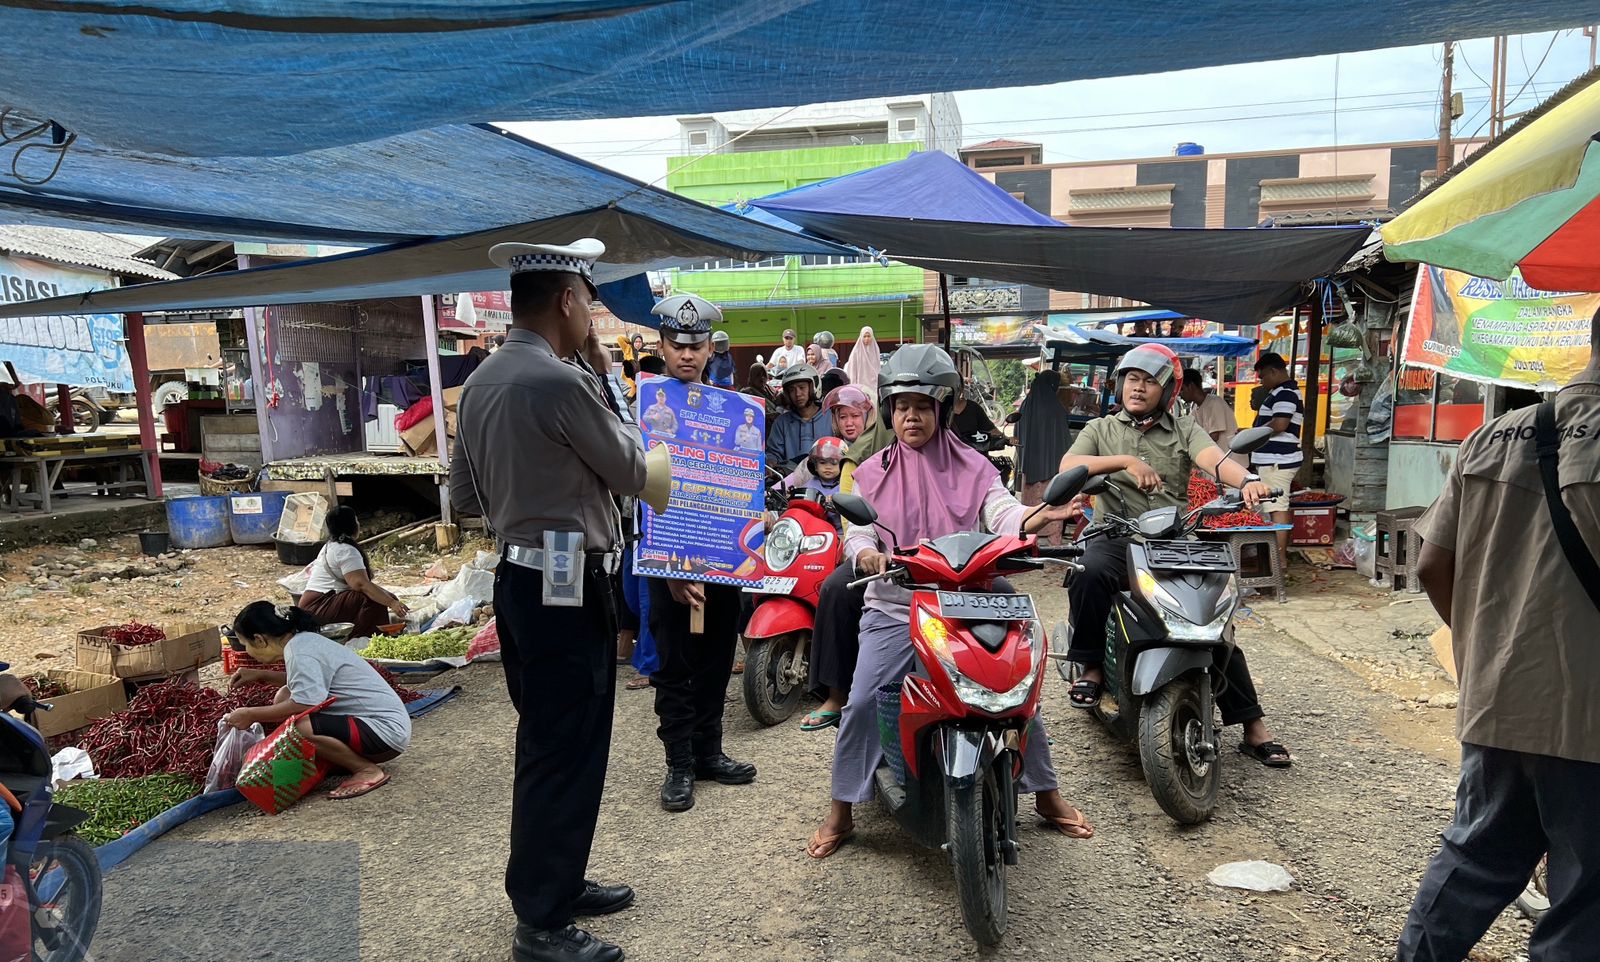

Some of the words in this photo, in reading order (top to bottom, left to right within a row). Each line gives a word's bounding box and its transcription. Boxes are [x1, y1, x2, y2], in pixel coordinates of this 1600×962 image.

[0, 274, 59, 302] ISASI
[1543, 305, 1572, 316] RANGKA
[1472, 318, 1522, 332] MENAMPUNG
[1524, 321, 1556, 332] ASPIRASI
[1489, 424, 1588, 445] PRIOTAS
[648, 440, 705, 460] COLING
[709, 452, 760, 470] SYSTEM
[688, 460, 716, 471] CEGAH
[718, 464, 764, 480] PROVOKASI
[682, 482, 752, 502] CIPTAKAN
[680, 500, 719, 513] PELANGGARAN
[744, 508, 763, 519] LINTAS
[944, 593, 964, 606] BM
[922, 683, 940, 708] HONDA
